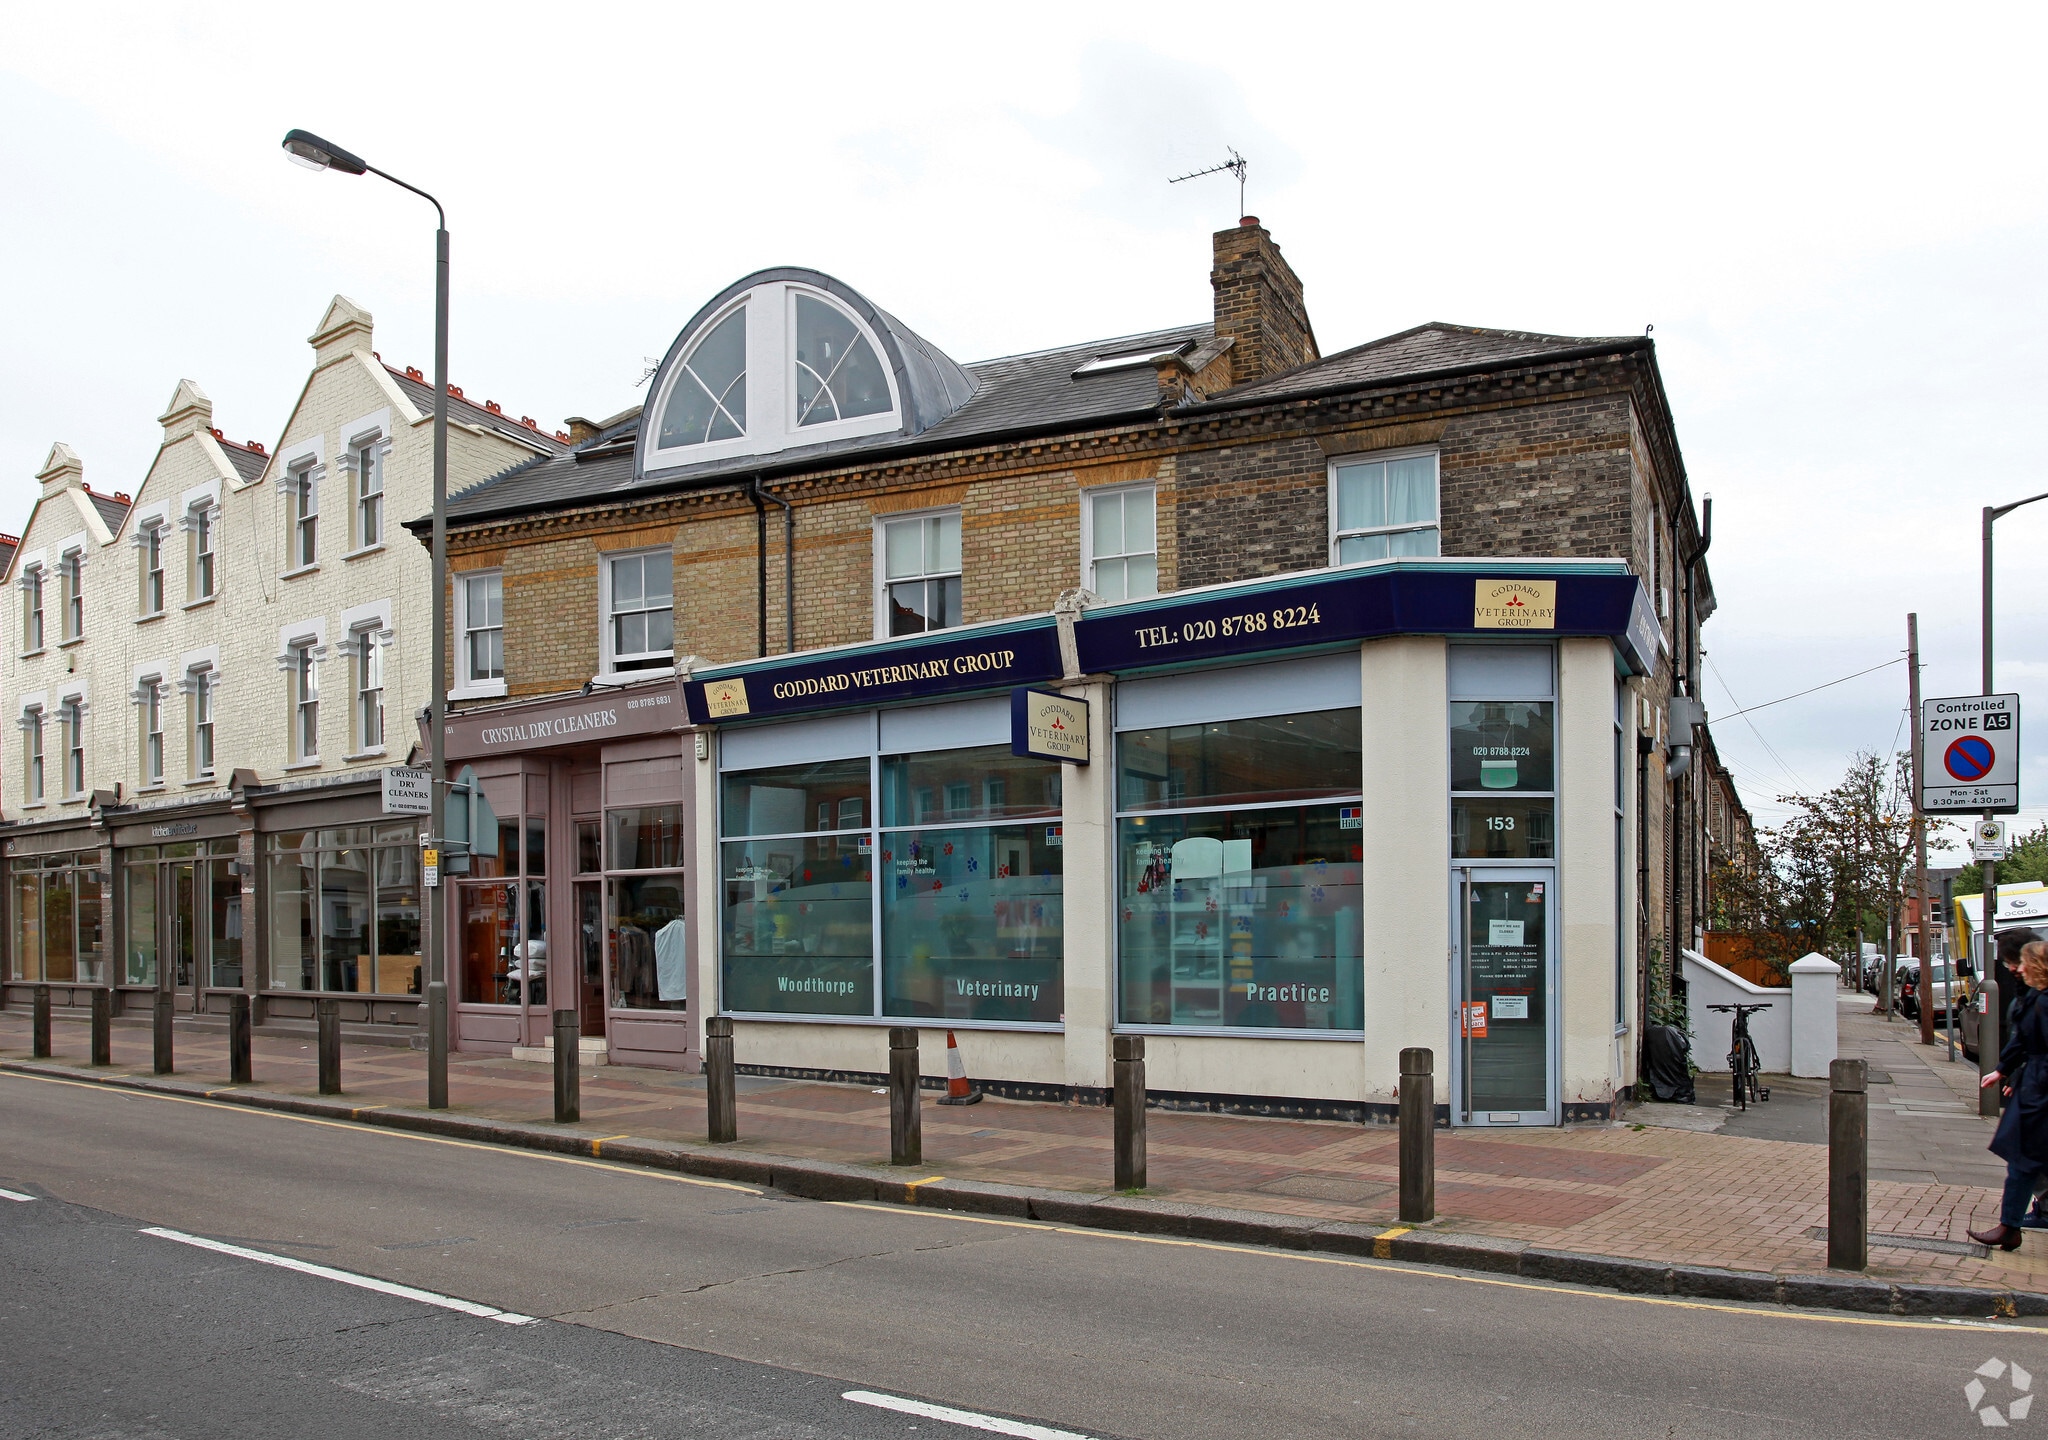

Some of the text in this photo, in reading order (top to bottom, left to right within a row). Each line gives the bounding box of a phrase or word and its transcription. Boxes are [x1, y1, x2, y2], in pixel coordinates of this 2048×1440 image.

[1491, 584, 1540, 598] GODDARD
[1476, 608, 1554, 618] VETERINARY
[1135, 602, 1321, 648] TEL: 020 8788 8224
[1497, 618, 1532, 627] GROUP
[773, 650, 1015, 699] GODDARD VETERINARY GROUP
[712, 683, 738, 696] GODDARD
[627, 695, 671, 709] 020 8785 6831
[708, 698, 747, 710] VETERINARY
[1936, 700, 2005, 713] Controlled
[720, 707, 737, 715] GROUP
[1040, 704, 1075, 723] GODDARD
[481, 709, 617, 744] CRYSTAL DRY CLEANERS
[1930, 715, 2008, 731] ZONE A5
[1030, 725, 1085, 746] VETERINARY
[1046, 741, 1071, 752] GROUP
[1473, 747, 1530, 756] 020 8788 8224
[390, 770, 424, 779] CRYSTAL
[399, 780, 415, 788] DRY
[388, 790, 429, 798] CLEANERS
[1342, 818, 1361, 828] Hill's
[1486, 816, 1515, 831] 153
[1136, 848, 1161, 856] keeing
[896, 859, 917, 867] keeping
[1136, 858, 1156, 866] family
[896, 867, 936, 876] family healthy
[2004, 908, 2038, 917] ocado
[778, 976, 855, 997] Woodthorpe
[956, 979, 1039, 1001] Veterinary
[1246, 982, 1330, 1003] Practice
